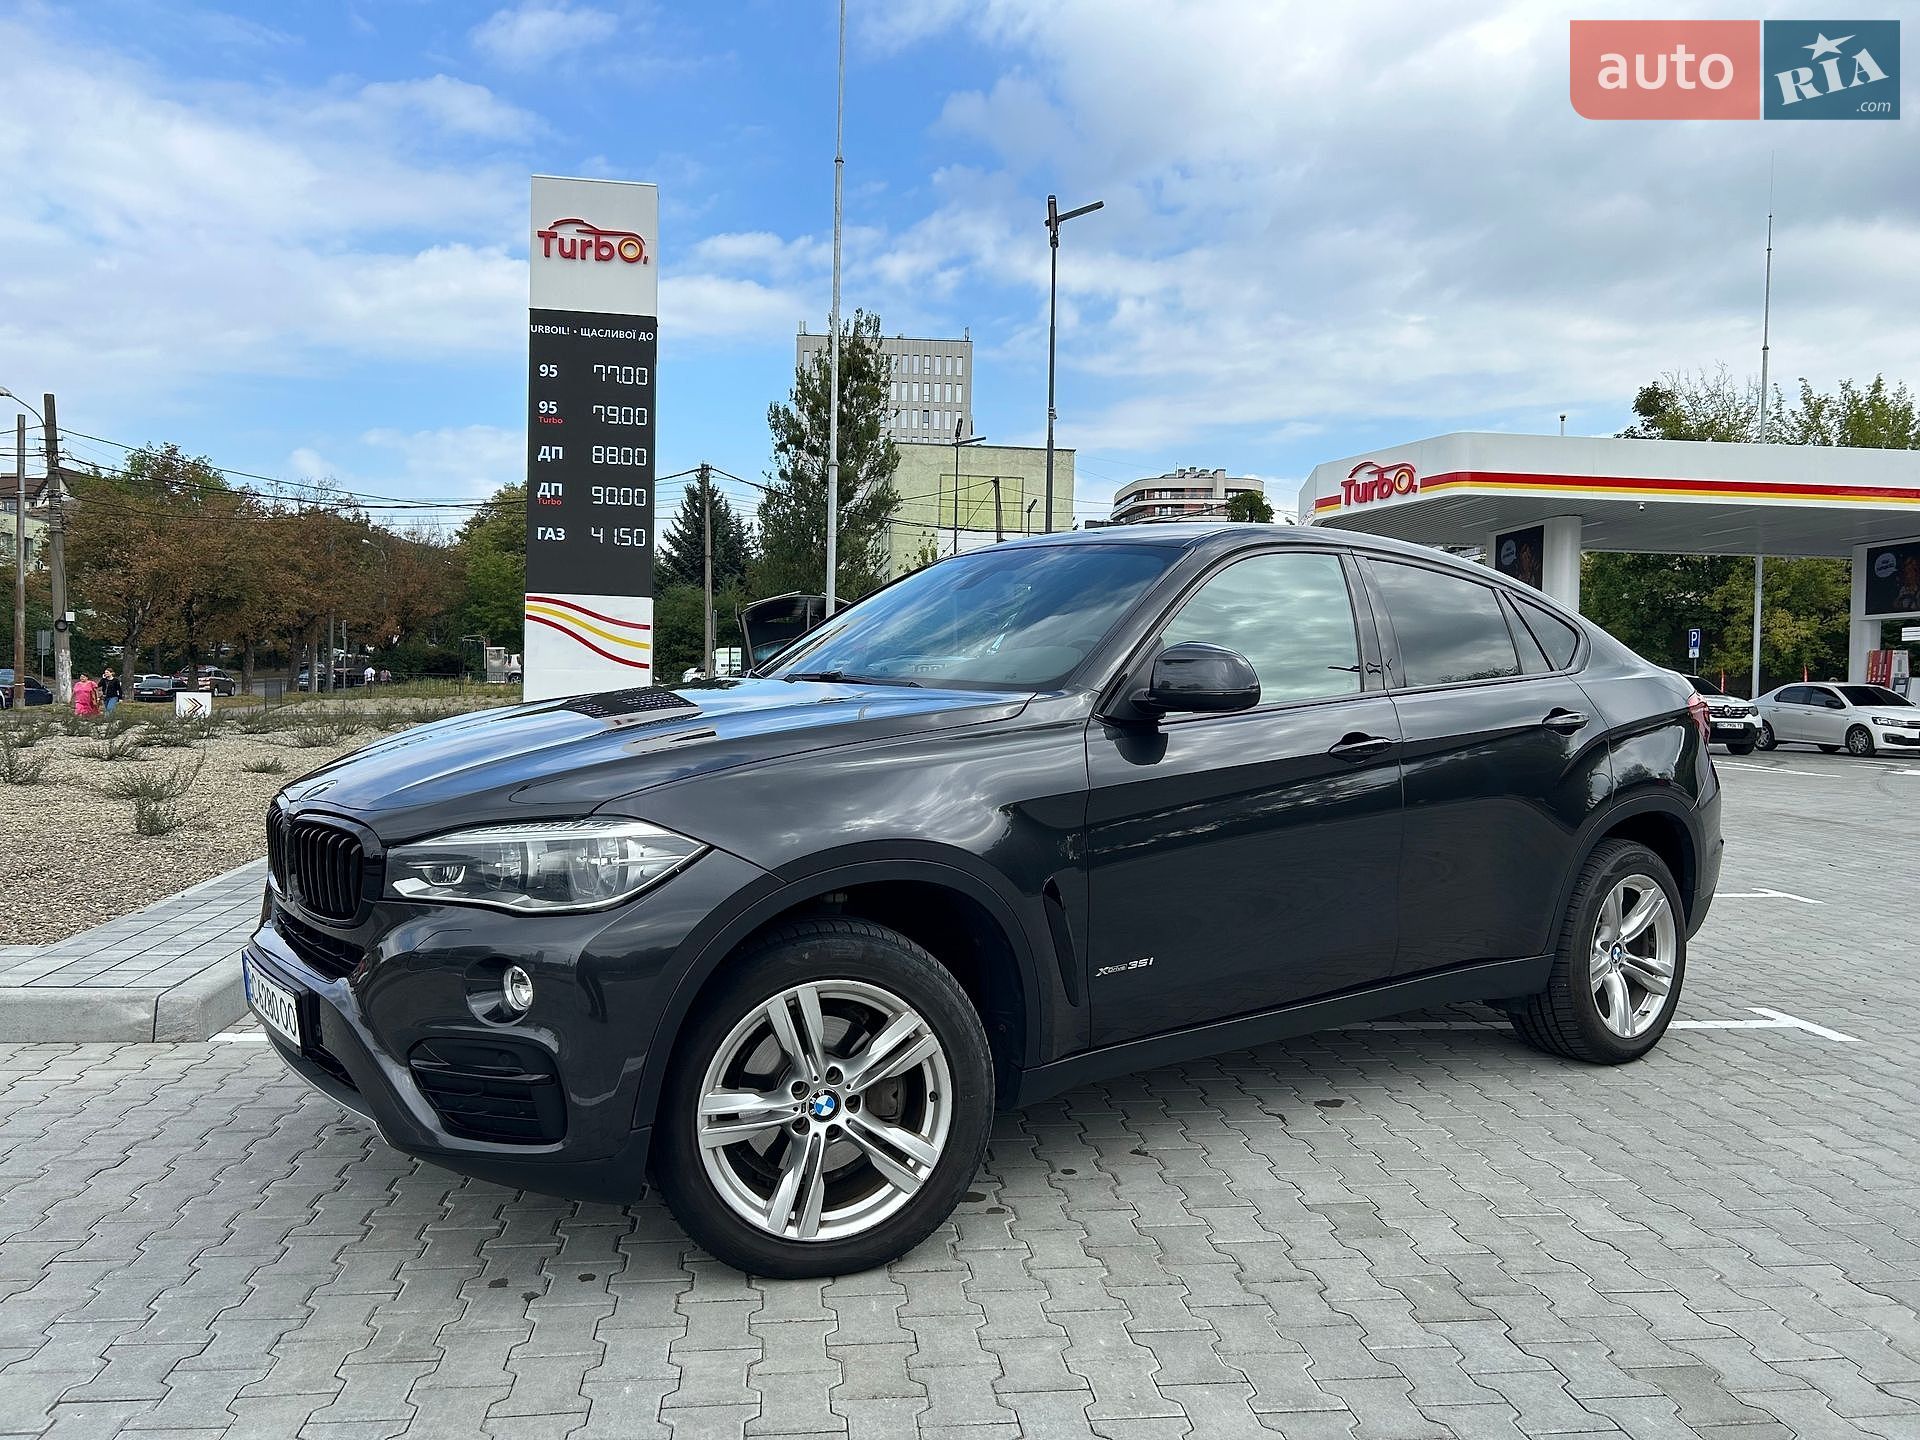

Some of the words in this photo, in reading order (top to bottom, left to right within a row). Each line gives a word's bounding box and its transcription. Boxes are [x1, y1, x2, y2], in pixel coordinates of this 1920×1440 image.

[530, 324, 570, 335] URBOIL!
[580, 327, 637, 341] ЩАСЛИВОЇ
[638, 332, 654, 341] ДО
[539, 363, 558, 378] 95
[593, 364, 648, 385] 77.00
[538, 400, 558, 414] 95
[592, 404, 647, 426] 79.00
[538, 415, 563, 424] Turbo
[537, 445, 563, 462] ДП
[592, 445, 647, 466] 88.00
[537, 482, 563, 499] ДП
[591, 486, 647, 507] 90.00
[538, 497, 562, 506] Turbo
[537, 526, 566, 541] ГАЗ
[1691, 631, 1698, 646] P
